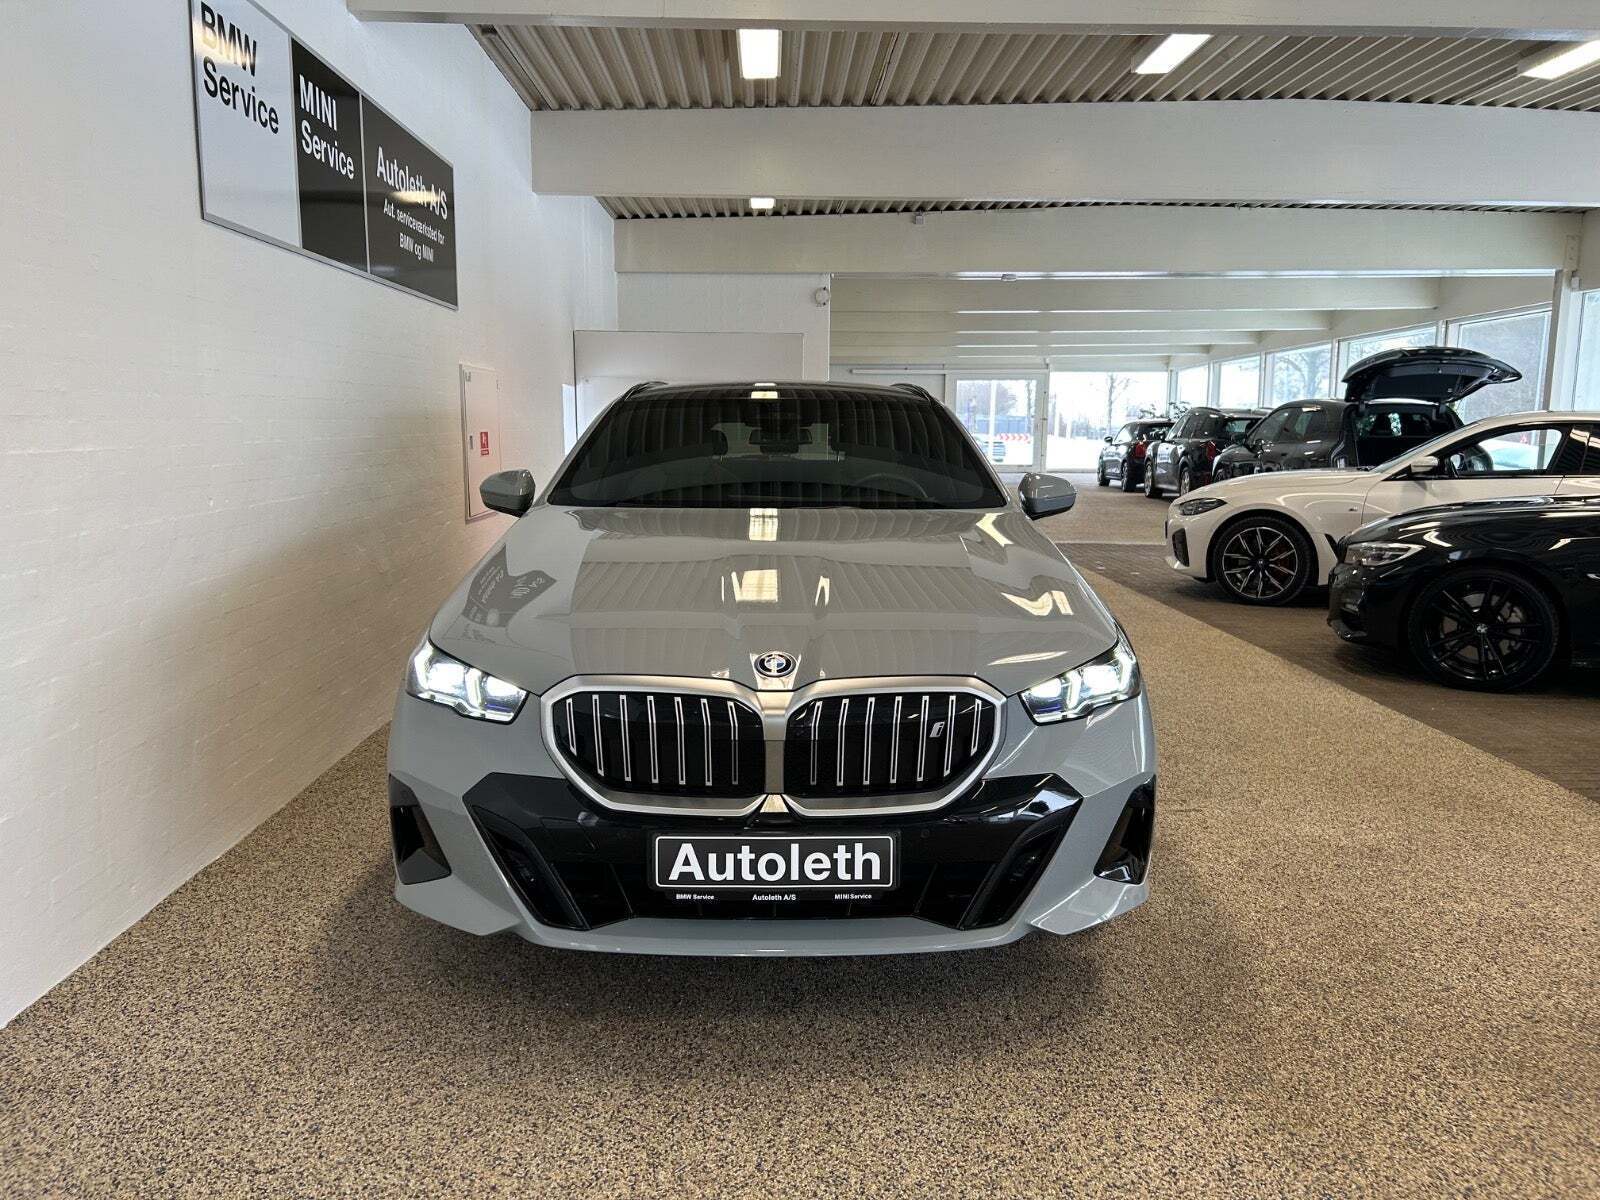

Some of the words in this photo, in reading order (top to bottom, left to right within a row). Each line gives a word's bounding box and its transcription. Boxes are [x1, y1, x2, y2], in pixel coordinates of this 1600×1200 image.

[201, 2, 257, 77] BMW
[203, 56, 279, 134] Service
[300, 75, 338, 131] MINI
[301, 119, 354, 180] Service
[376, 146, 427, 207] Autoleth
[429, 183, 448, 220] A/S
[399, 232, 414, 252] BMW
[422, 244, 434, 262] MINI
[668, 842, 881, 882] Autoleth
